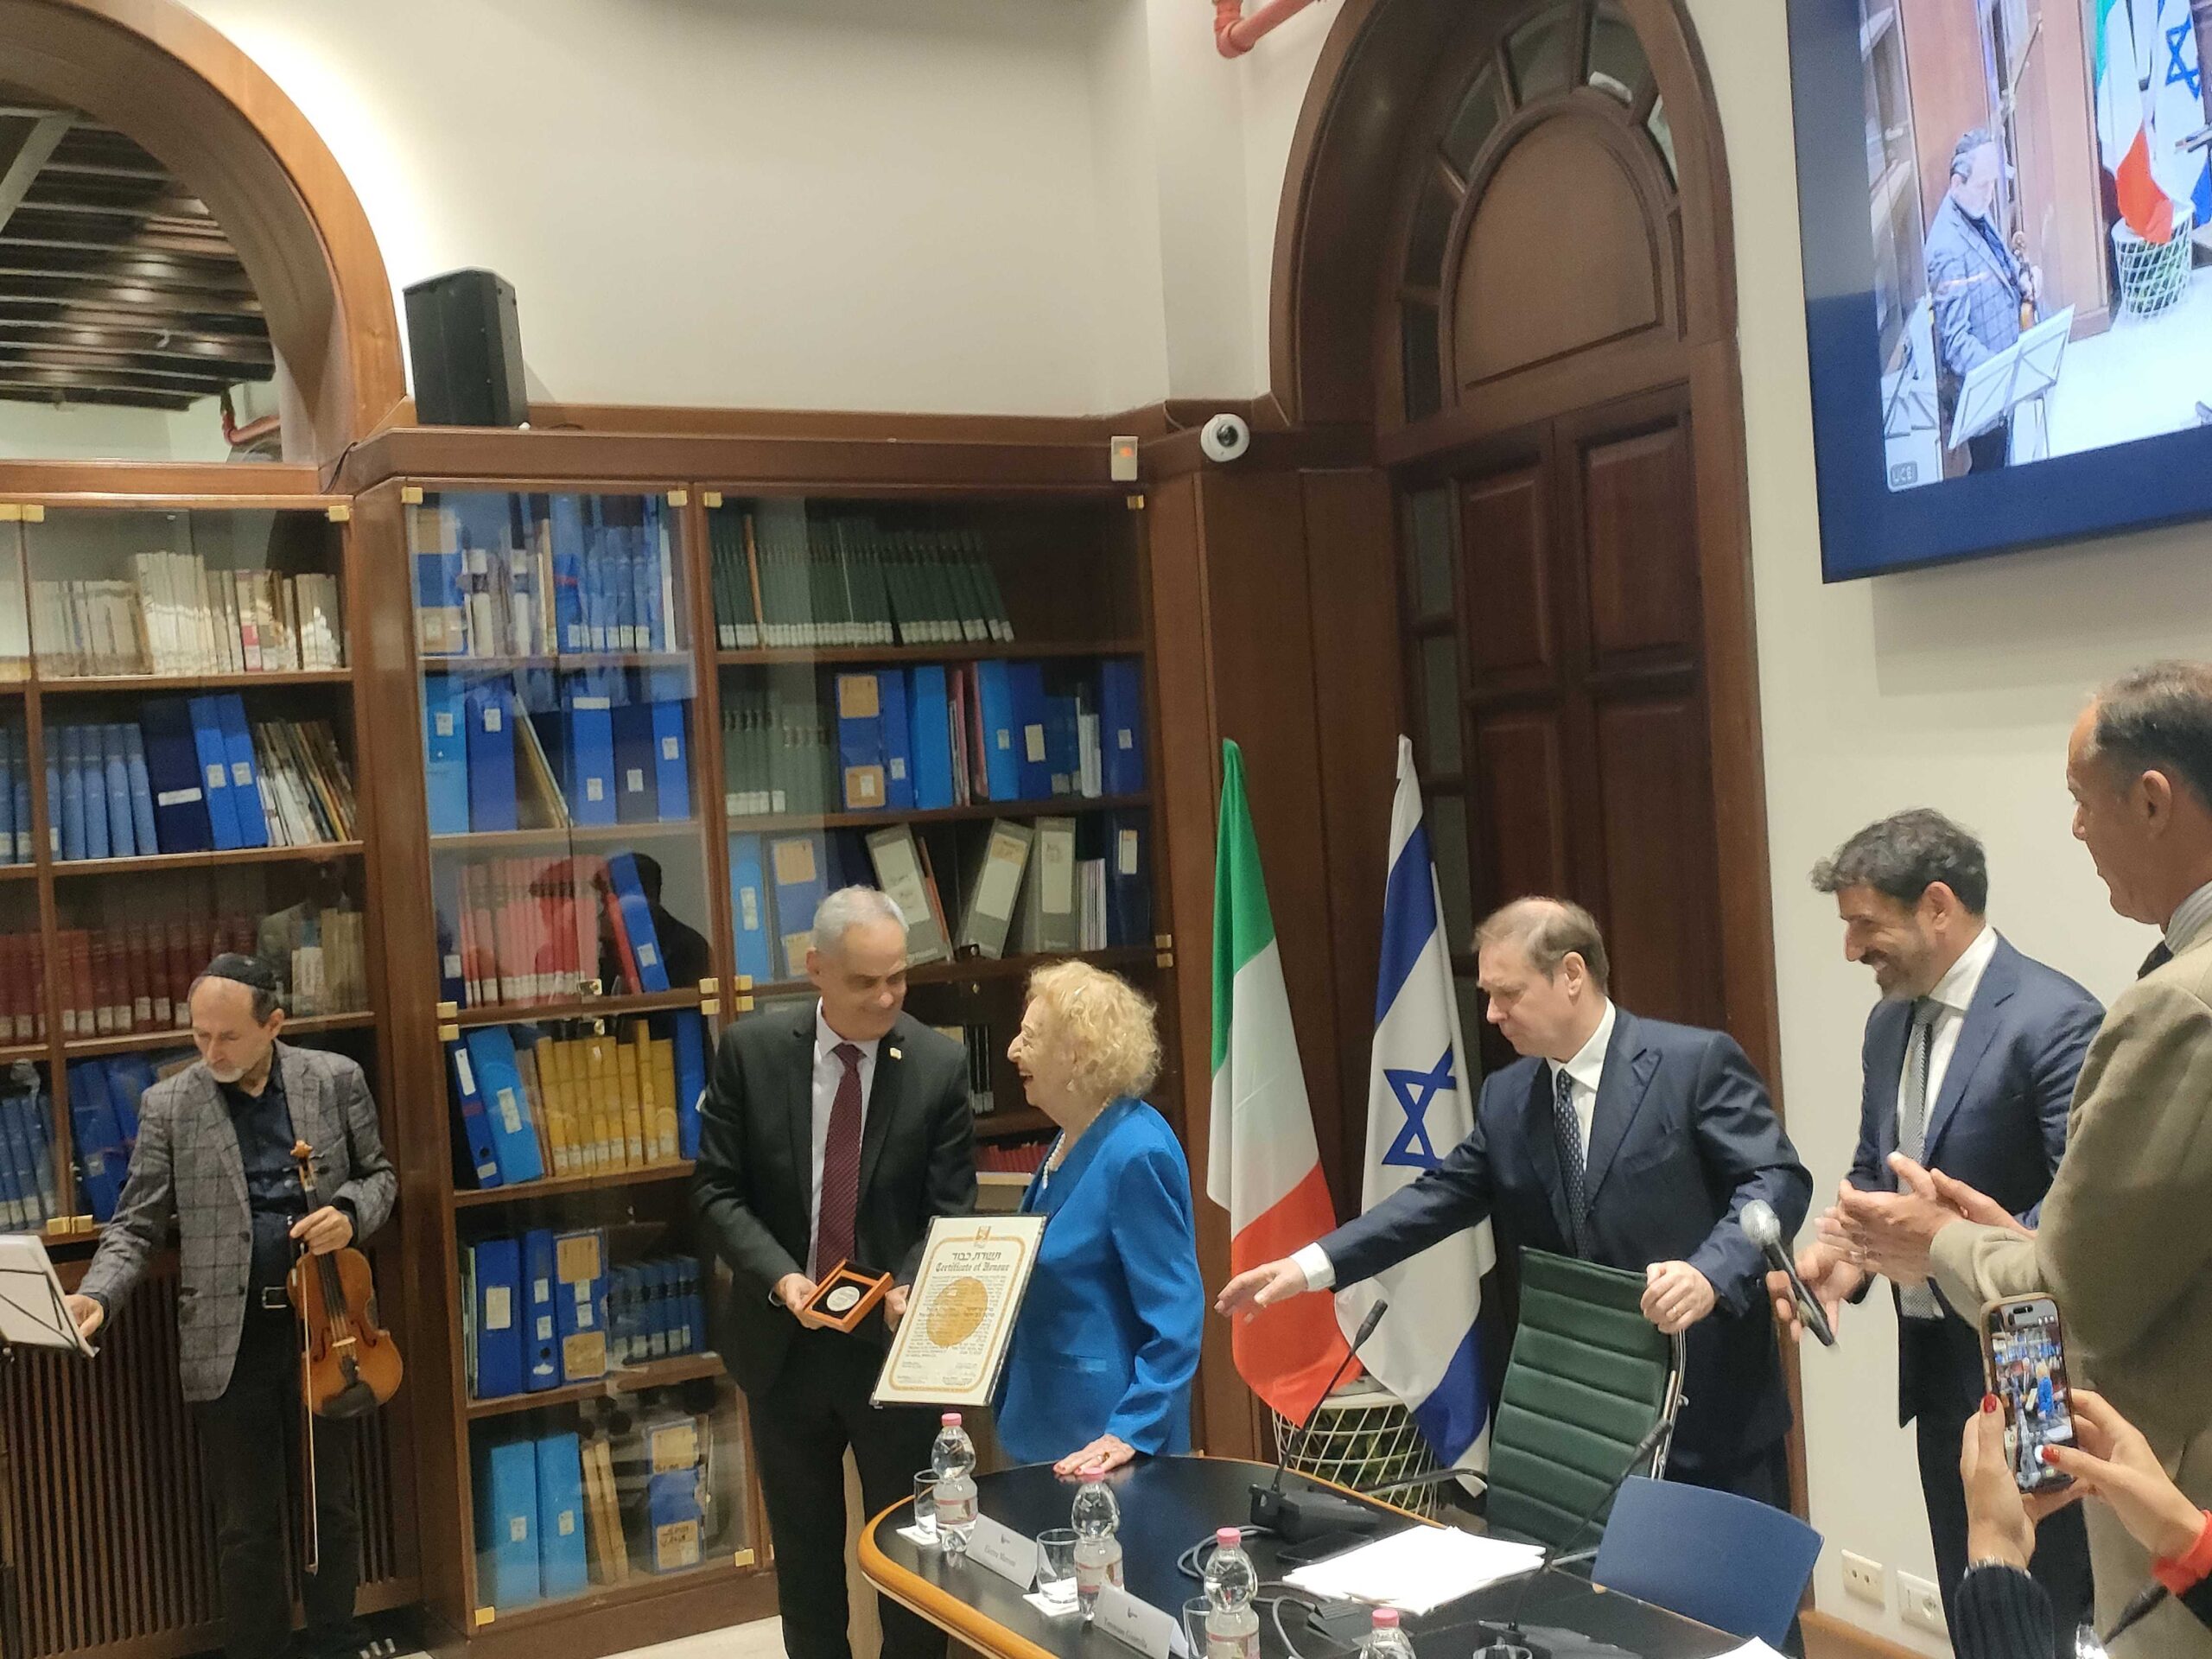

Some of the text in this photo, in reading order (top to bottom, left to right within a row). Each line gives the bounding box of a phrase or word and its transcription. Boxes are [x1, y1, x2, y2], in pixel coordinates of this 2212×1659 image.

[951, 1252, 971, 1261] כבוד
[936, 1262, 972, 1272] Certificate
[973, 1262, 982, 1272] of
